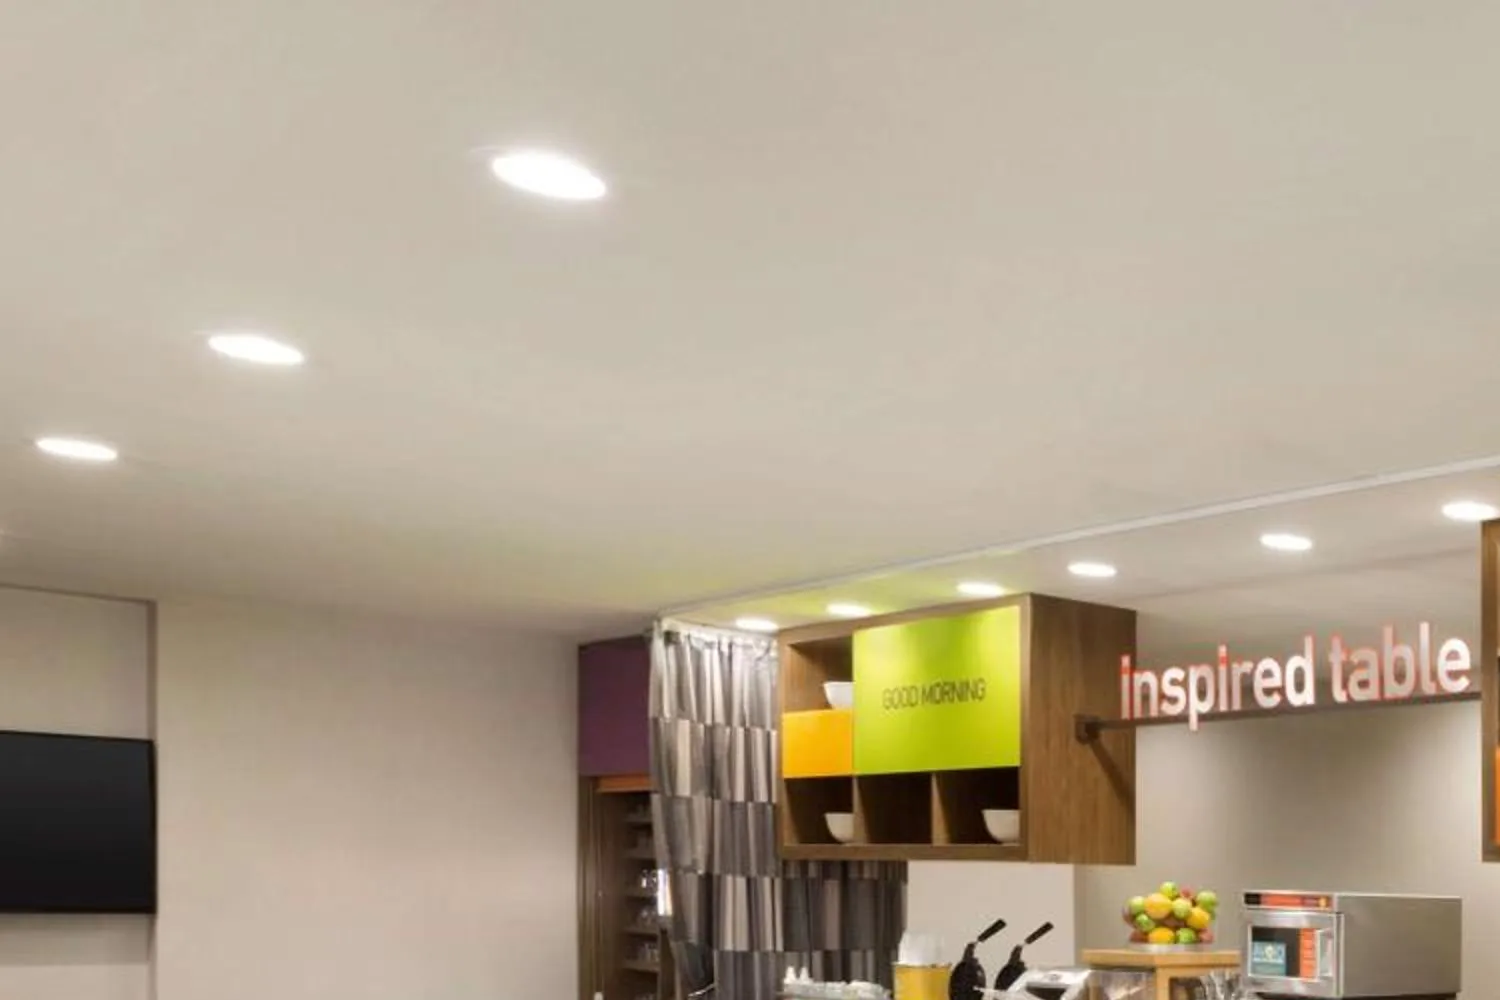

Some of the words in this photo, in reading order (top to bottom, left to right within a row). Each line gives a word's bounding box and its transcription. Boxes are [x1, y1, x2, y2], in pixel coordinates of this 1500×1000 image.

[882, 685, 919, 710] GOOD
[921, 677, 986, 705] MORNING
[1120, 635, 1316, 731] inspired
[1328, 621, 1472, 703] table
